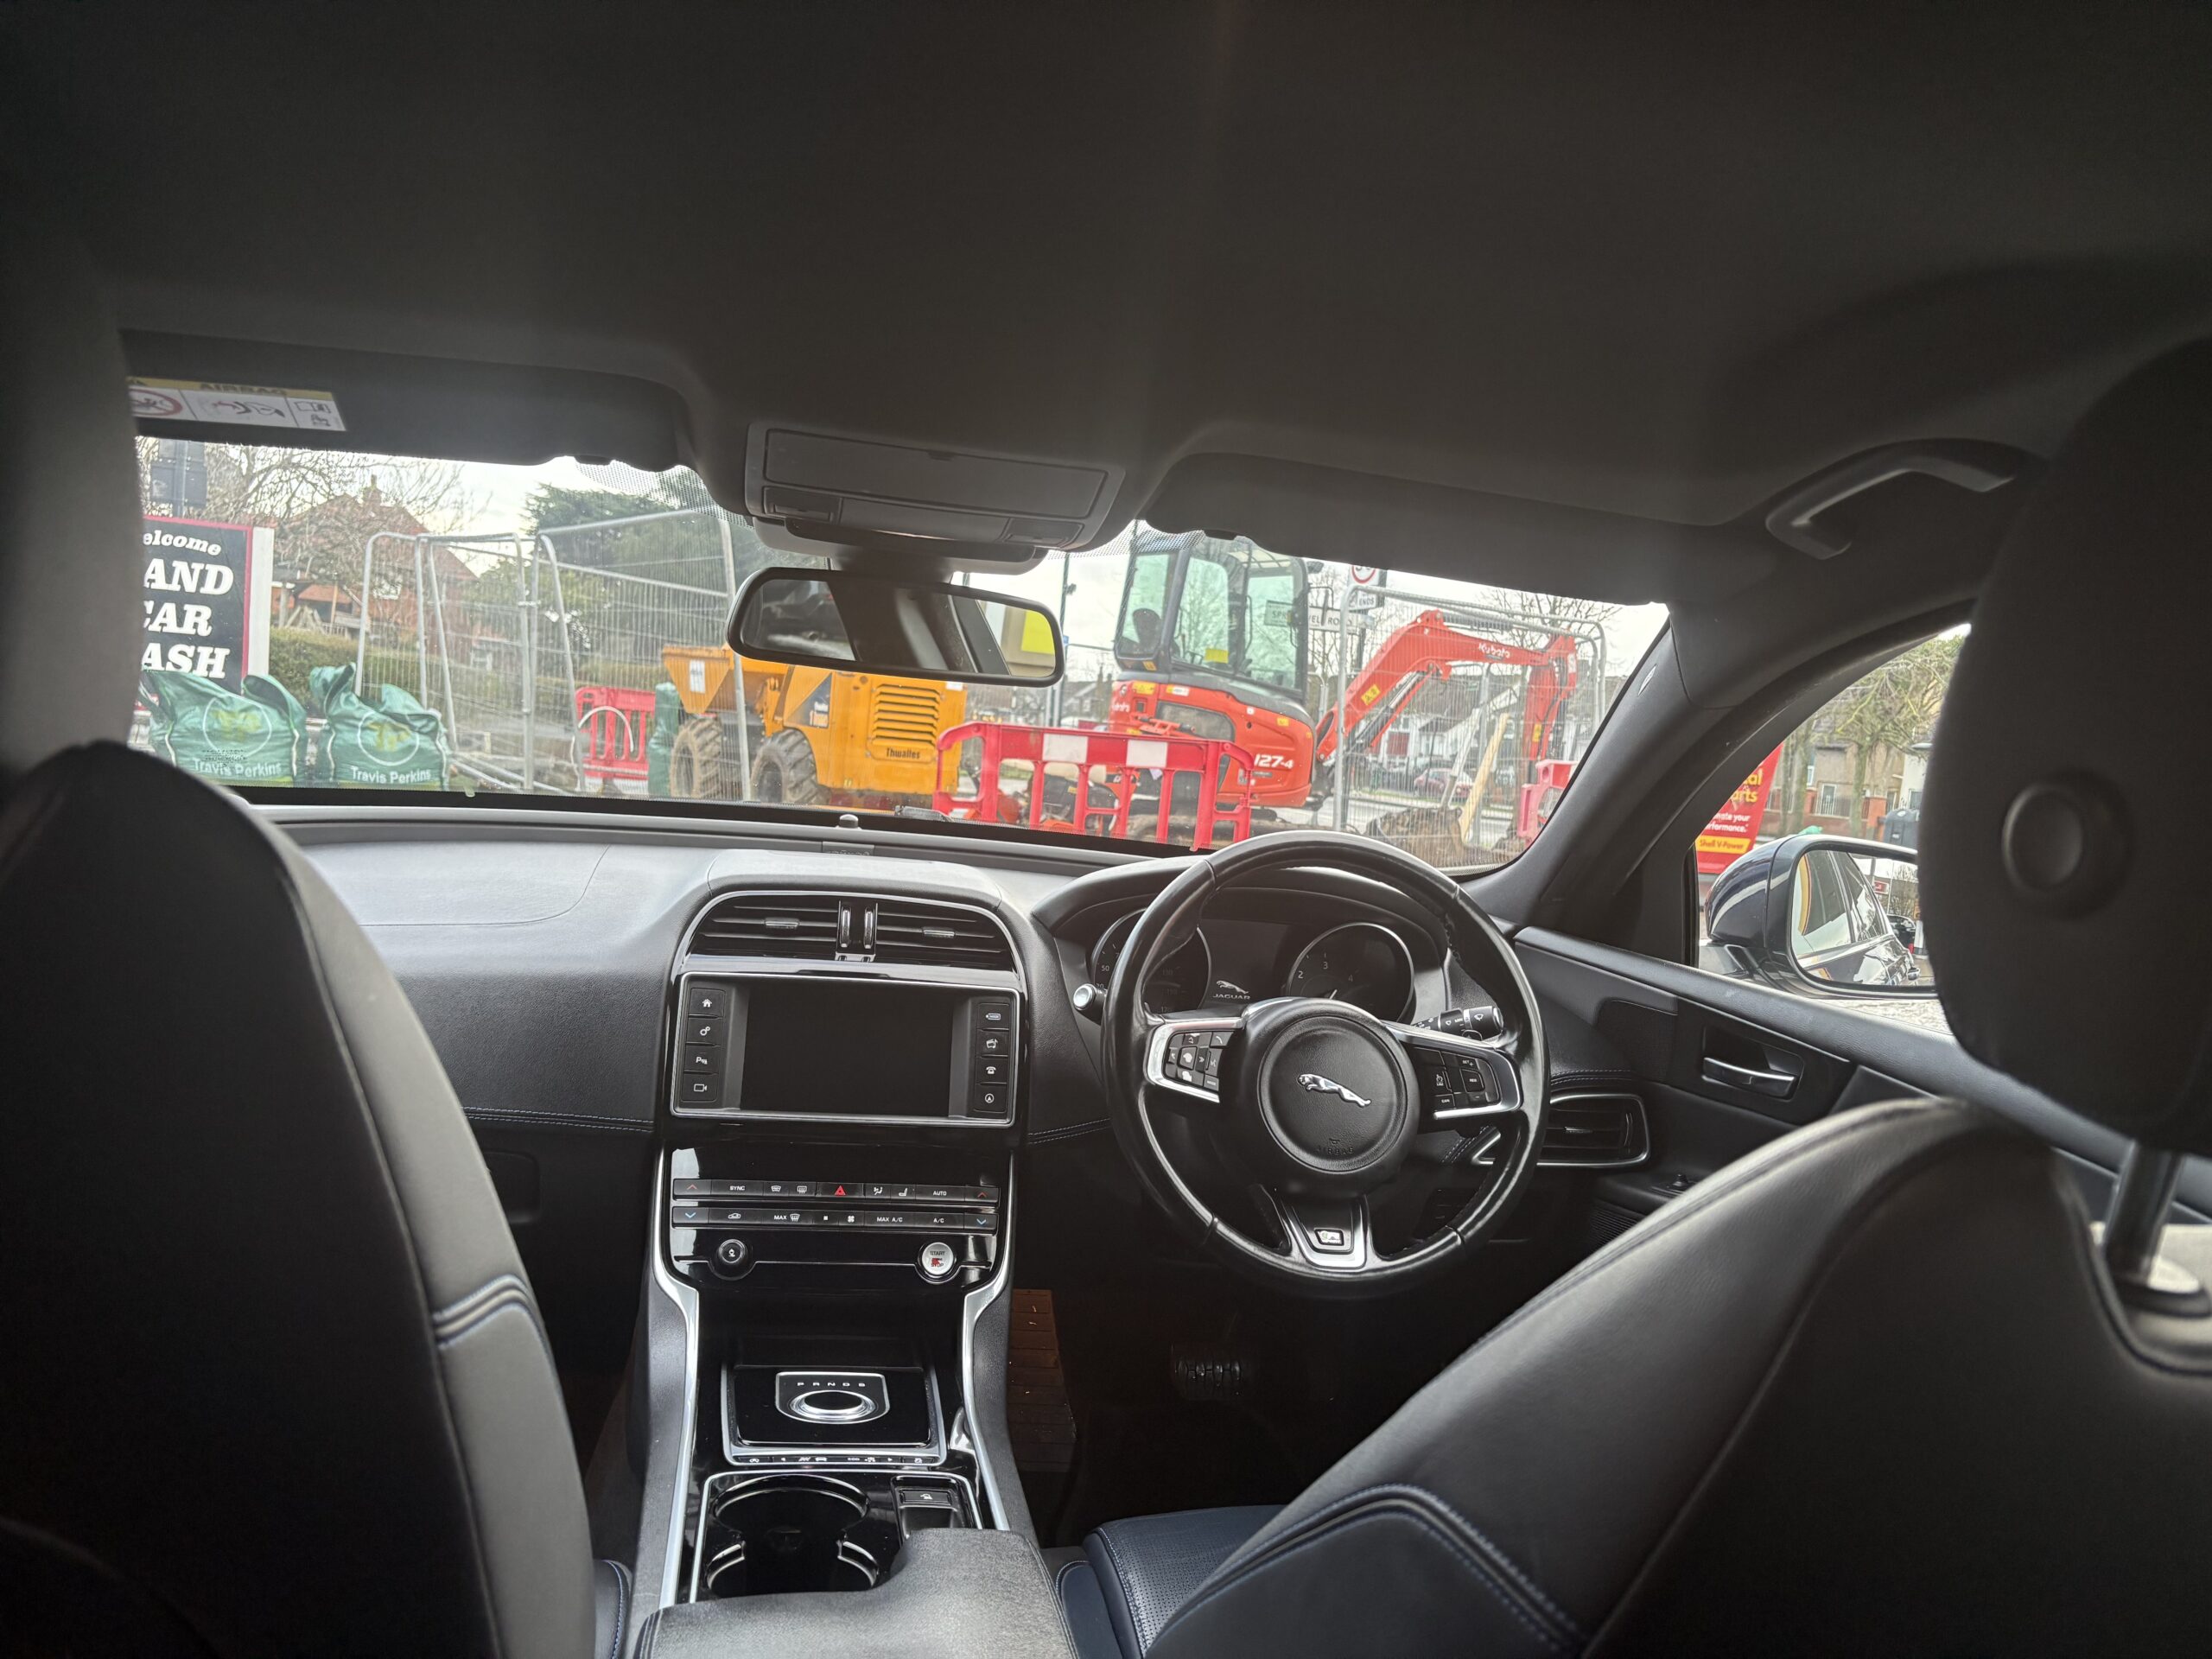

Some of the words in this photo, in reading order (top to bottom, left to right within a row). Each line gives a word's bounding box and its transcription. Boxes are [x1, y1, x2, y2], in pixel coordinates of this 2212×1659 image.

[143, 529, 222, 556] elcome
[143, 557, 234, 595] AND
[1478, 643, 1510, 658] Kubota
[142, 642, 231, 679] ASH
[886, 747, 921, 759] Thwaites
[193, 758, 232, 777] Travis
[234, 761, 283, 779] Perkins
[350, 766, 387, 785] Travis
[390, 767, 432, 785] Perkins
[1730, 787, 1758, 803] arts
[1733, 814, 1751, 823] your
[1700, 838, 1716, 848] Shell
[1717, 840, 1744, 850] V-Power
[1323, 961, 1328, 969] 3
[1298, 970, 1304, 979] 2
